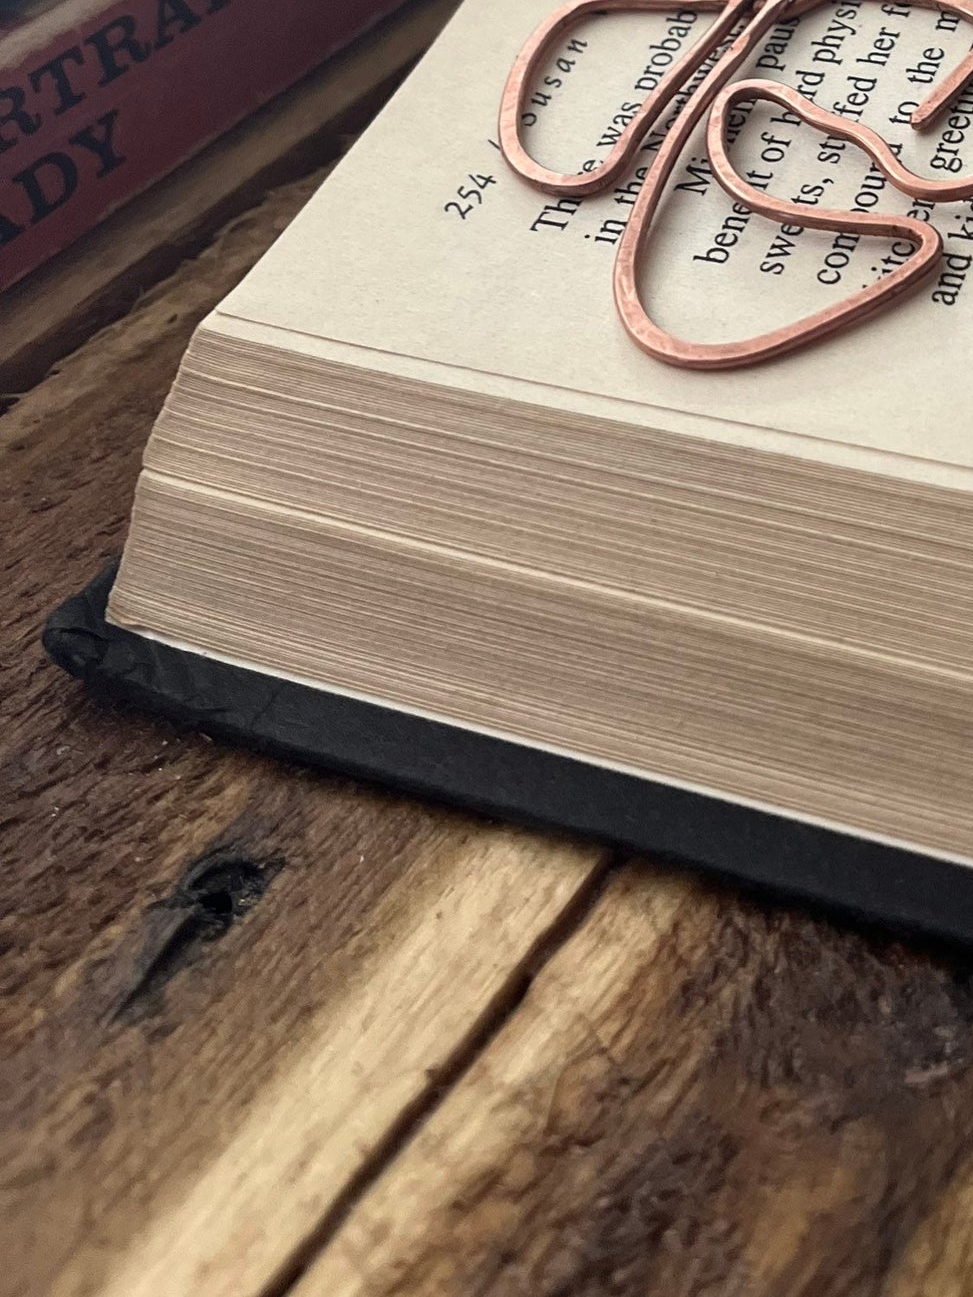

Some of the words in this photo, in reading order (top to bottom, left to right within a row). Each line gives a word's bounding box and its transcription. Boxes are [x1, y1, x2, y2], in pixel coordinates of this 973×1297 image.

[855, 25, 900, 67] her
[904, 46, 945, 84] the
[597, 102, 641, 146] was
[759, 130, 792, 163] of
[444, 170, 498, 221] 254
[931, 251, 972, 306] and
